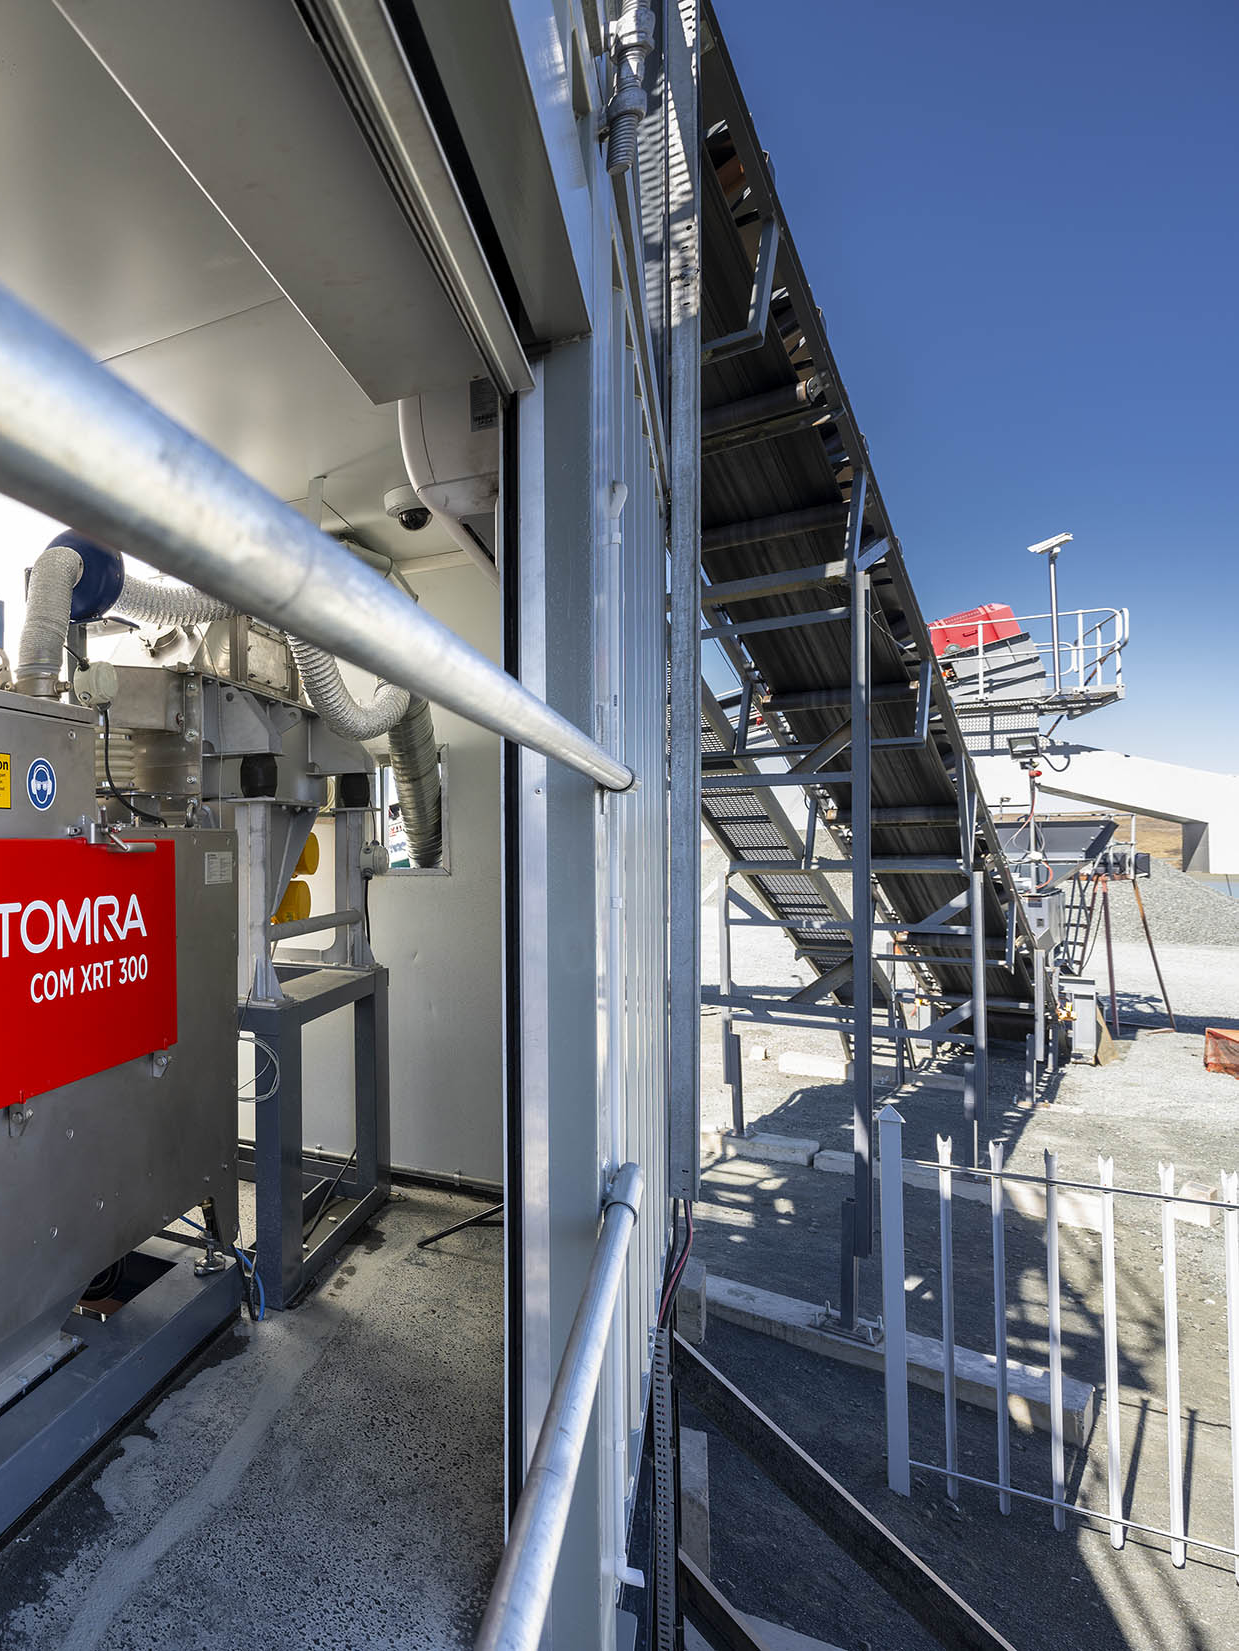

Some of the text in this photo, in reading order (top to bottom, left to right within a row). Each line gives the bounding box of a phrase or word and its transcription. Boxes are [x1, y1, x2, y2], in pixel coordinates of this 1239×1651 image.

[30, 953, 149, 1003] COM XRT 300
